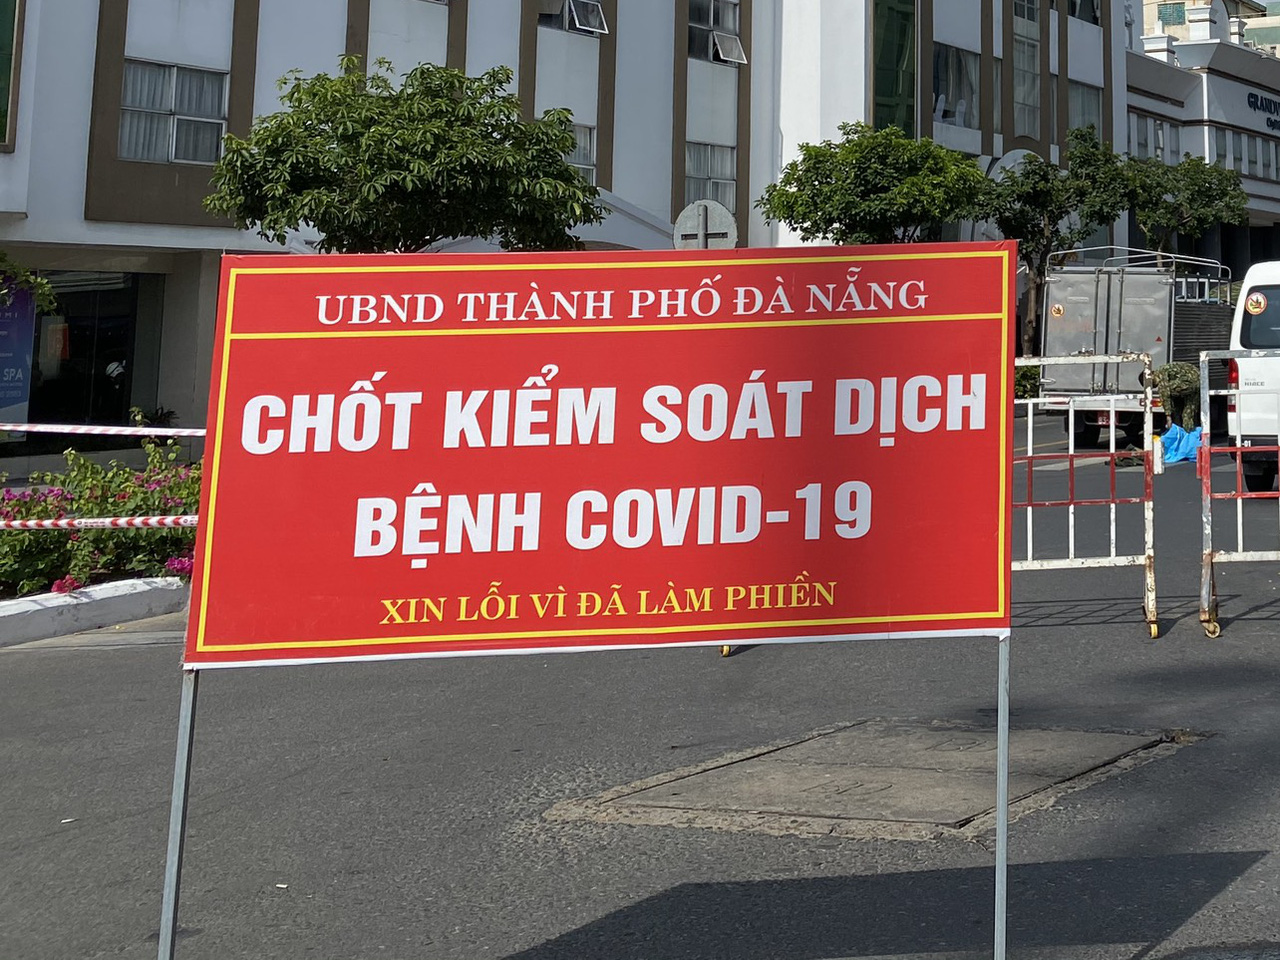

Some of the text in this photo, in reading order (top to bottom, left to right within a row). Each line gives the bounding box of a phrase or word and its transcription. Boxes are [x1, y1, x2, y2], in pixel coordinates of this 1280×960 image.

[318, 269, 928, 325] UBND THÀNH PHỐ ĐÀ NẴNG
[3, 368, 23, 380] SPA
[243, 365, 987, 455] CHỐT KIỂM SOÁT DỊCH
[355, 482, 872, 569] BỆNH COVID-19
[381, 572, 835, 625] XIN LỖI VÌ ĐÃ LÀM PHIỀN
